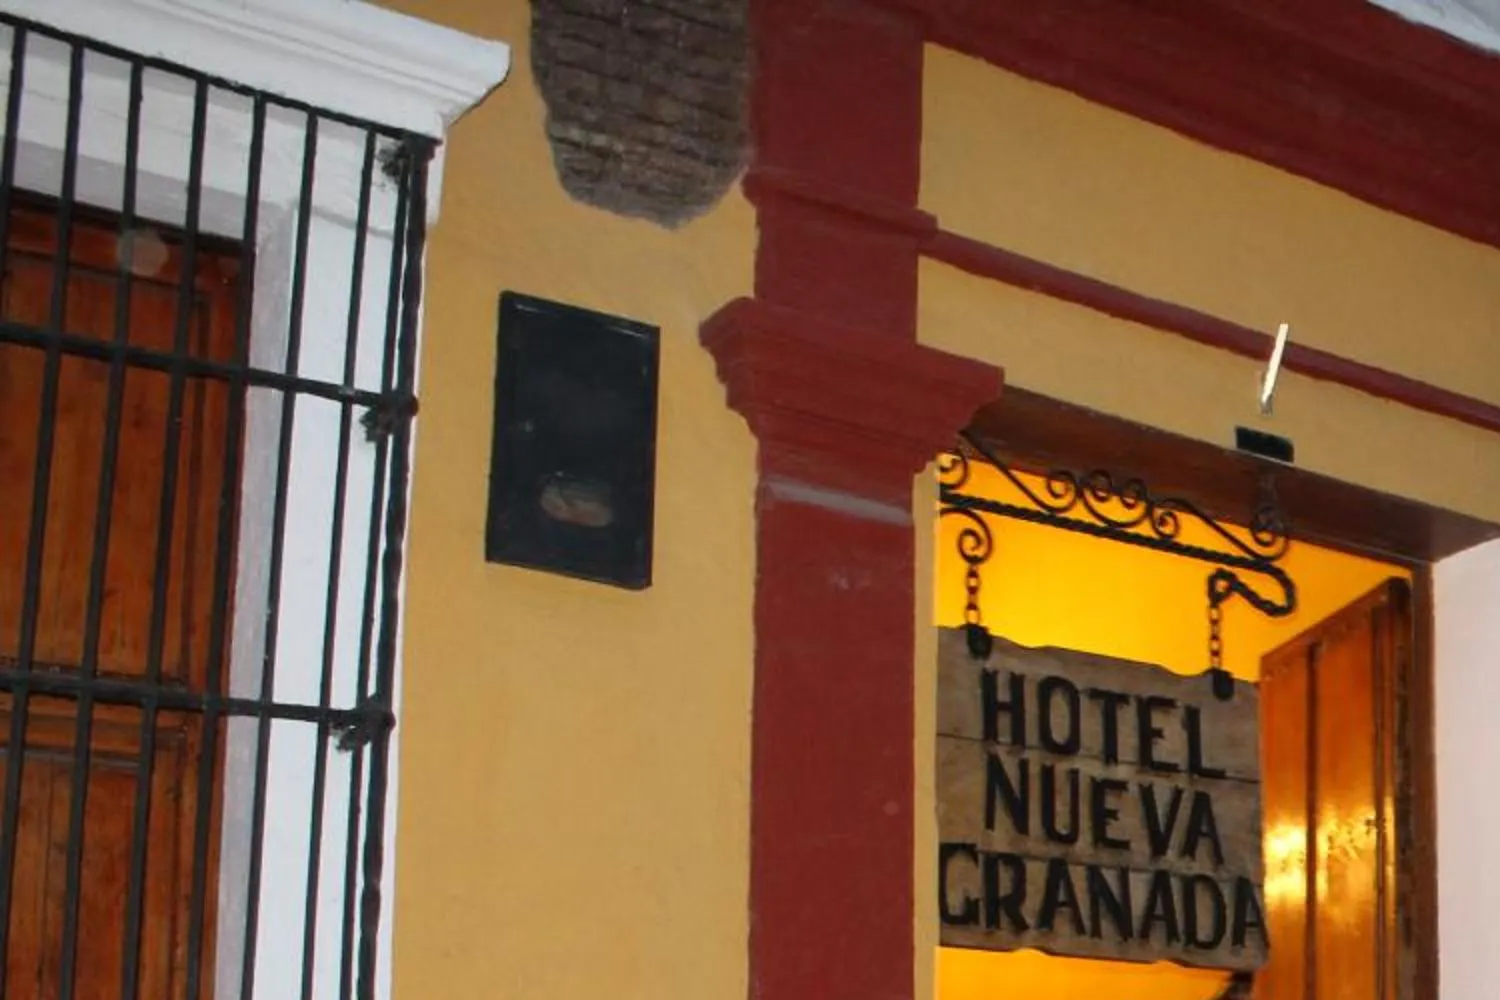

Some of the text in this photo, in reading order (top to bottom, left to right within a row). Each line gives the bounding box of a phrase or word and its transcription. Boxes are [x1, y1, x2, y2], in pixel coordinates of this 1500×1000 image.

[980, 669, 1227, 780] HOTEL
[984, 752, 1225, 865] NUEVA
[938, 841, 1271, 951] GRANADA
